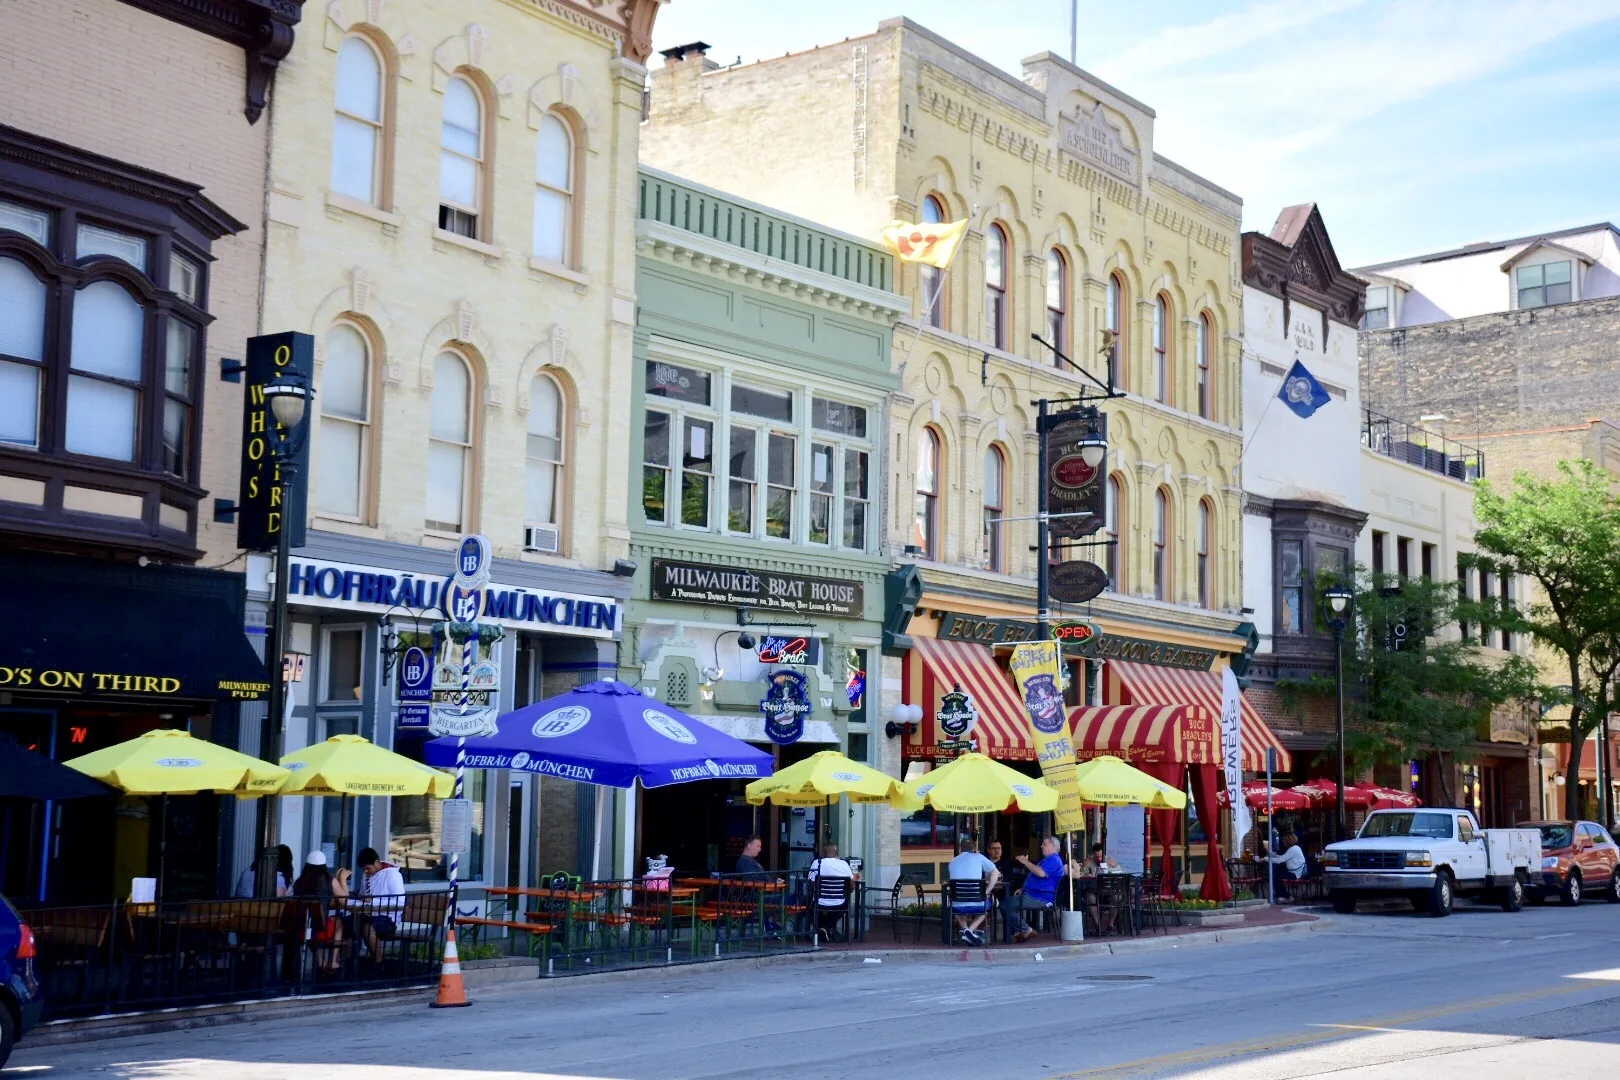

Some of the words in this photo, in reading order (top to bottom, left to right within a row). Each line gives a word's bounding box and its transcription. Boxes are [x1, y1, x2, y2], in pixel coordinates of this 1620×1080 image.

[1050, 484, 1099, 501] BRADLEY'S
[463, 556, 477, 572] HB
[665, 566, 760, 593] MILWAUKEE
[769, 577, 805, 598] BRAT
[810, 582, 854, 603] HOUSE
[290, 563, 439, 610] HOFBRÄU
[485, 589, 617, 631] MÜNCHEN
[949, 617, 1000, 641] BUCK
[1055, 626, 1091, 639] OPEN
[1095, 637, 1151, 660] SALOON
[1162, 647, 1213, 667] EATERY
[406, 665, 421, 682] HB
[40, 670, 85, 690] ON
[92, 672, 181, 694] THIRD
[231, 690, 259, 699] PUB
[436, 715, 485, 731] BIERGARTEN
[541, 720, 570, 734] HB
[1188, 719, 1205, 730] BUCK
[906, 746, 924, 755] BUCK
[991, 747, 1007, 756] BUCK
[1077, 750, 1093, 759] BUCK
[461, 753, 511, 768] OFBRÄU
[526, 758, 594, 780] MÜNCHEN
[670, 765, 710, 781] HOFBRÄU
[719, 764, 758, 776] MÜNCHEN
